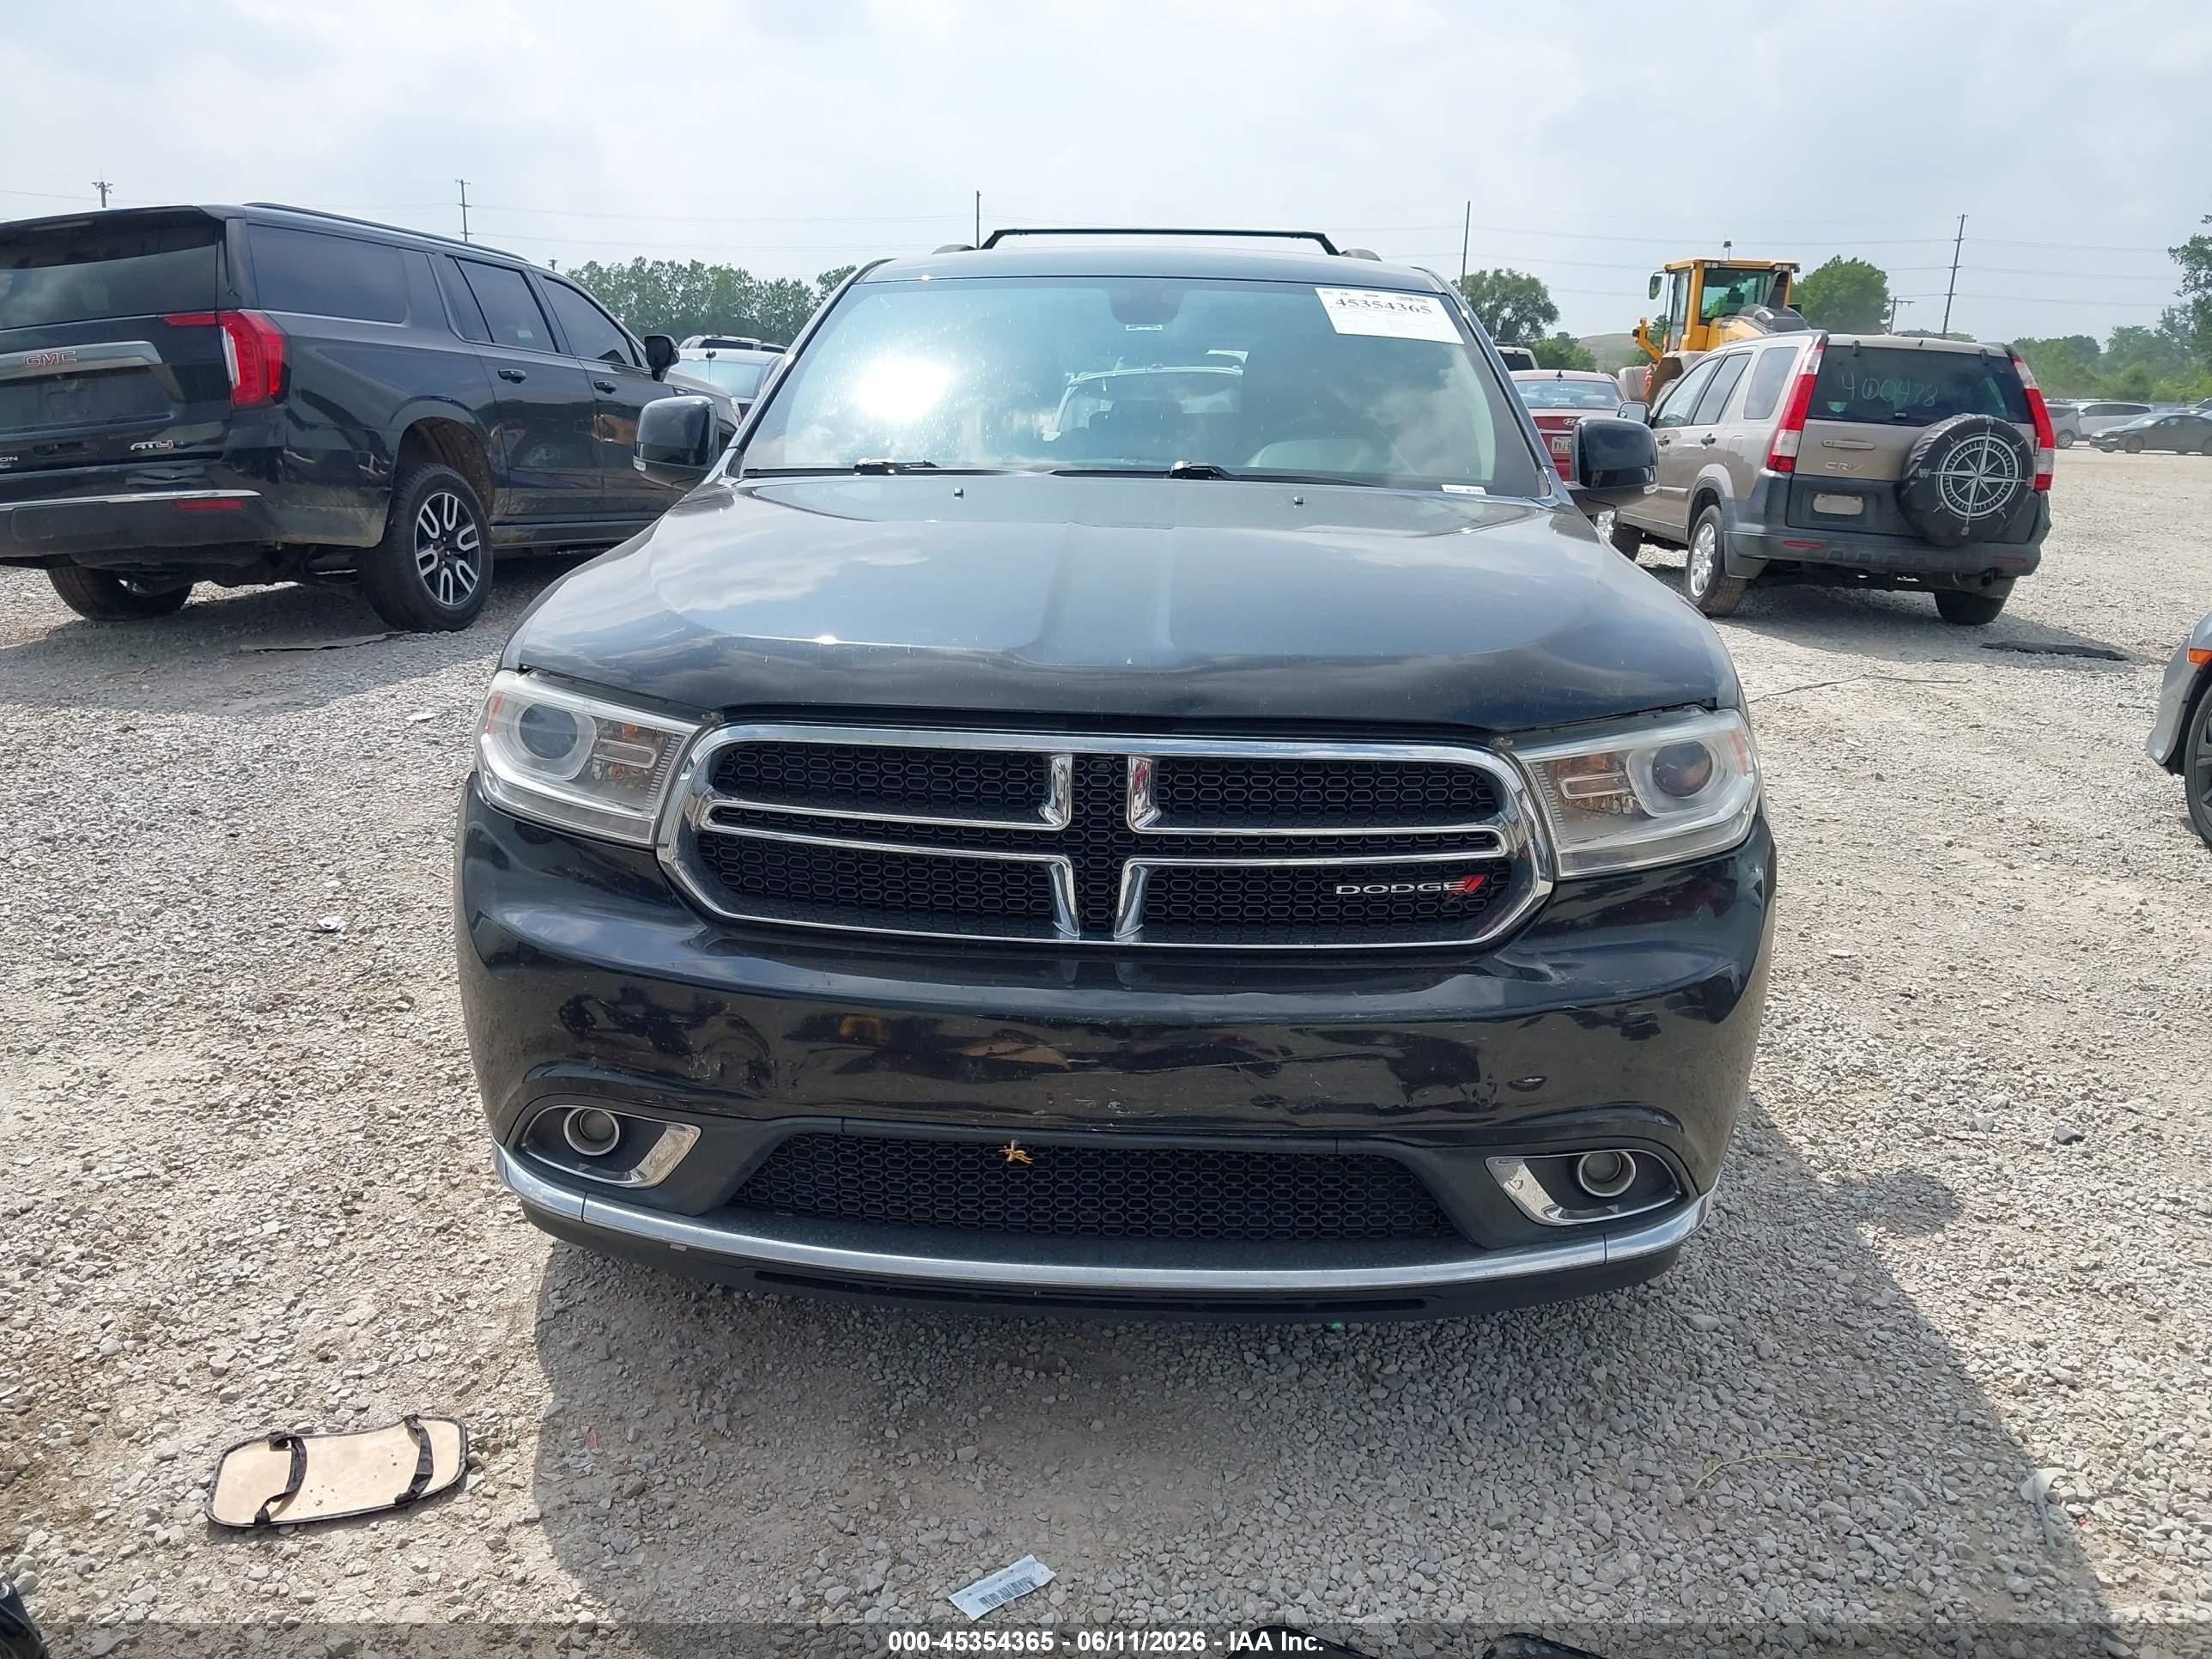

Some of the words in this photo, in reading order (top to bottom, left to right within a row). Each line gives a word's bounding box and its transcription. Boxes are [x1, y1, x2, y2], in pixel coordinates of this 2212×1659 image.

[1335, 297, 1432, 315] 45354365
[24, 349, 78, 368] GMC
[130, 440, 174, 451] AT4
[1825, 460, 1864, 472] CR-V
[1335, 880, 1467, 896] DODGE
